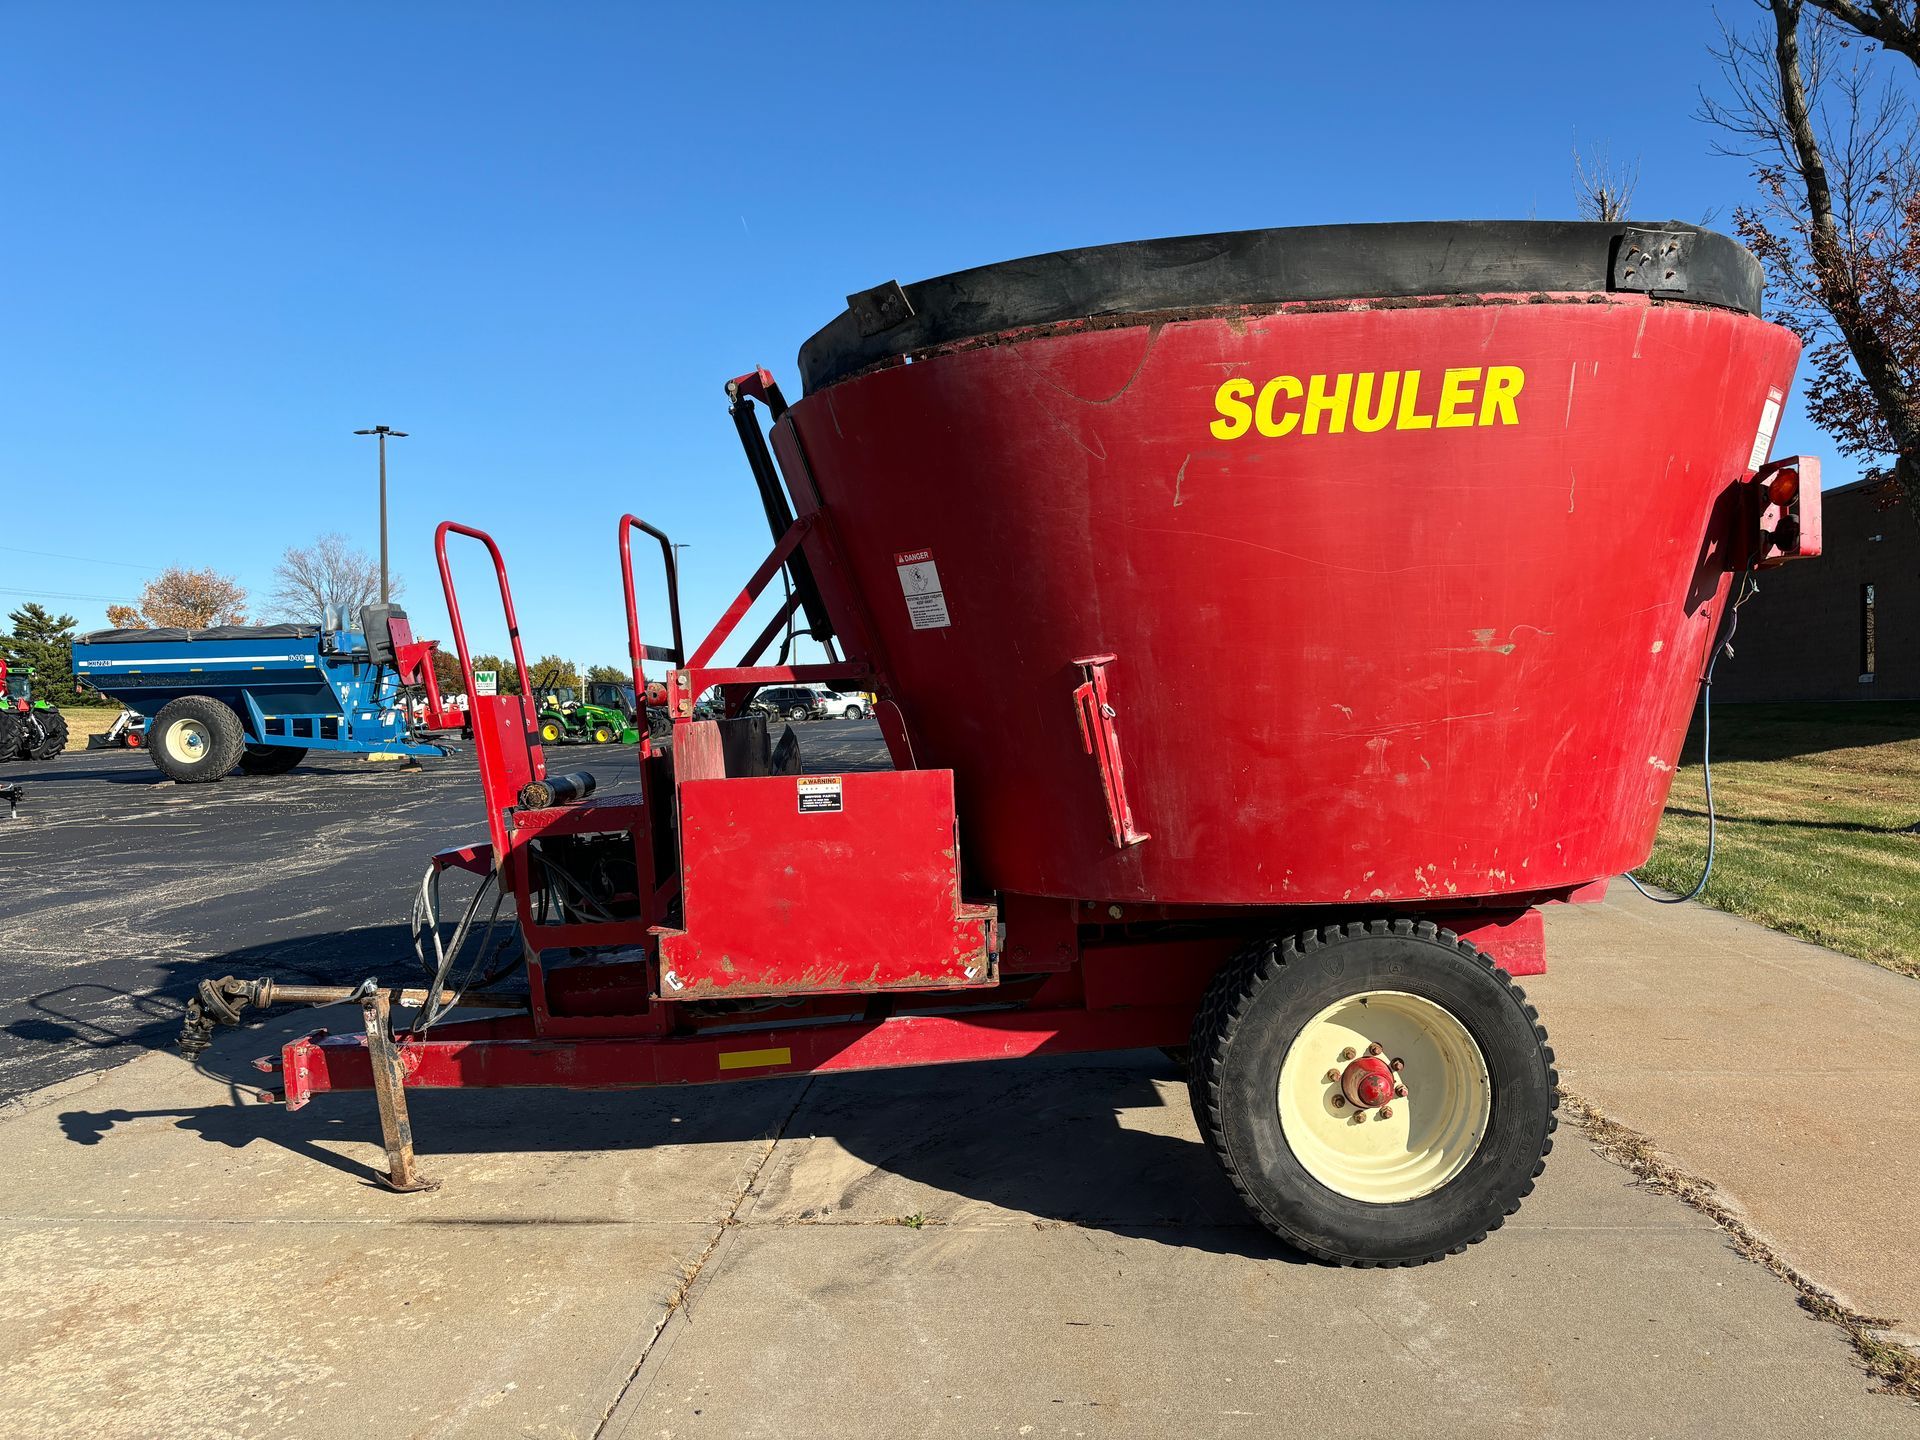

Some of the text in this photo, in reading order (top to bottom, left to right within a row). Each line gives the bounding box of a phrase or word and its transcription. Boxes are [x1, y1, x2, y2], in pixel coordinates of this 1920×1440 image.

[1209, 365, 1526, 441] SCHULER
[904, 551, 929, 562] DANGER
[476, 673, 495, 682] NW
